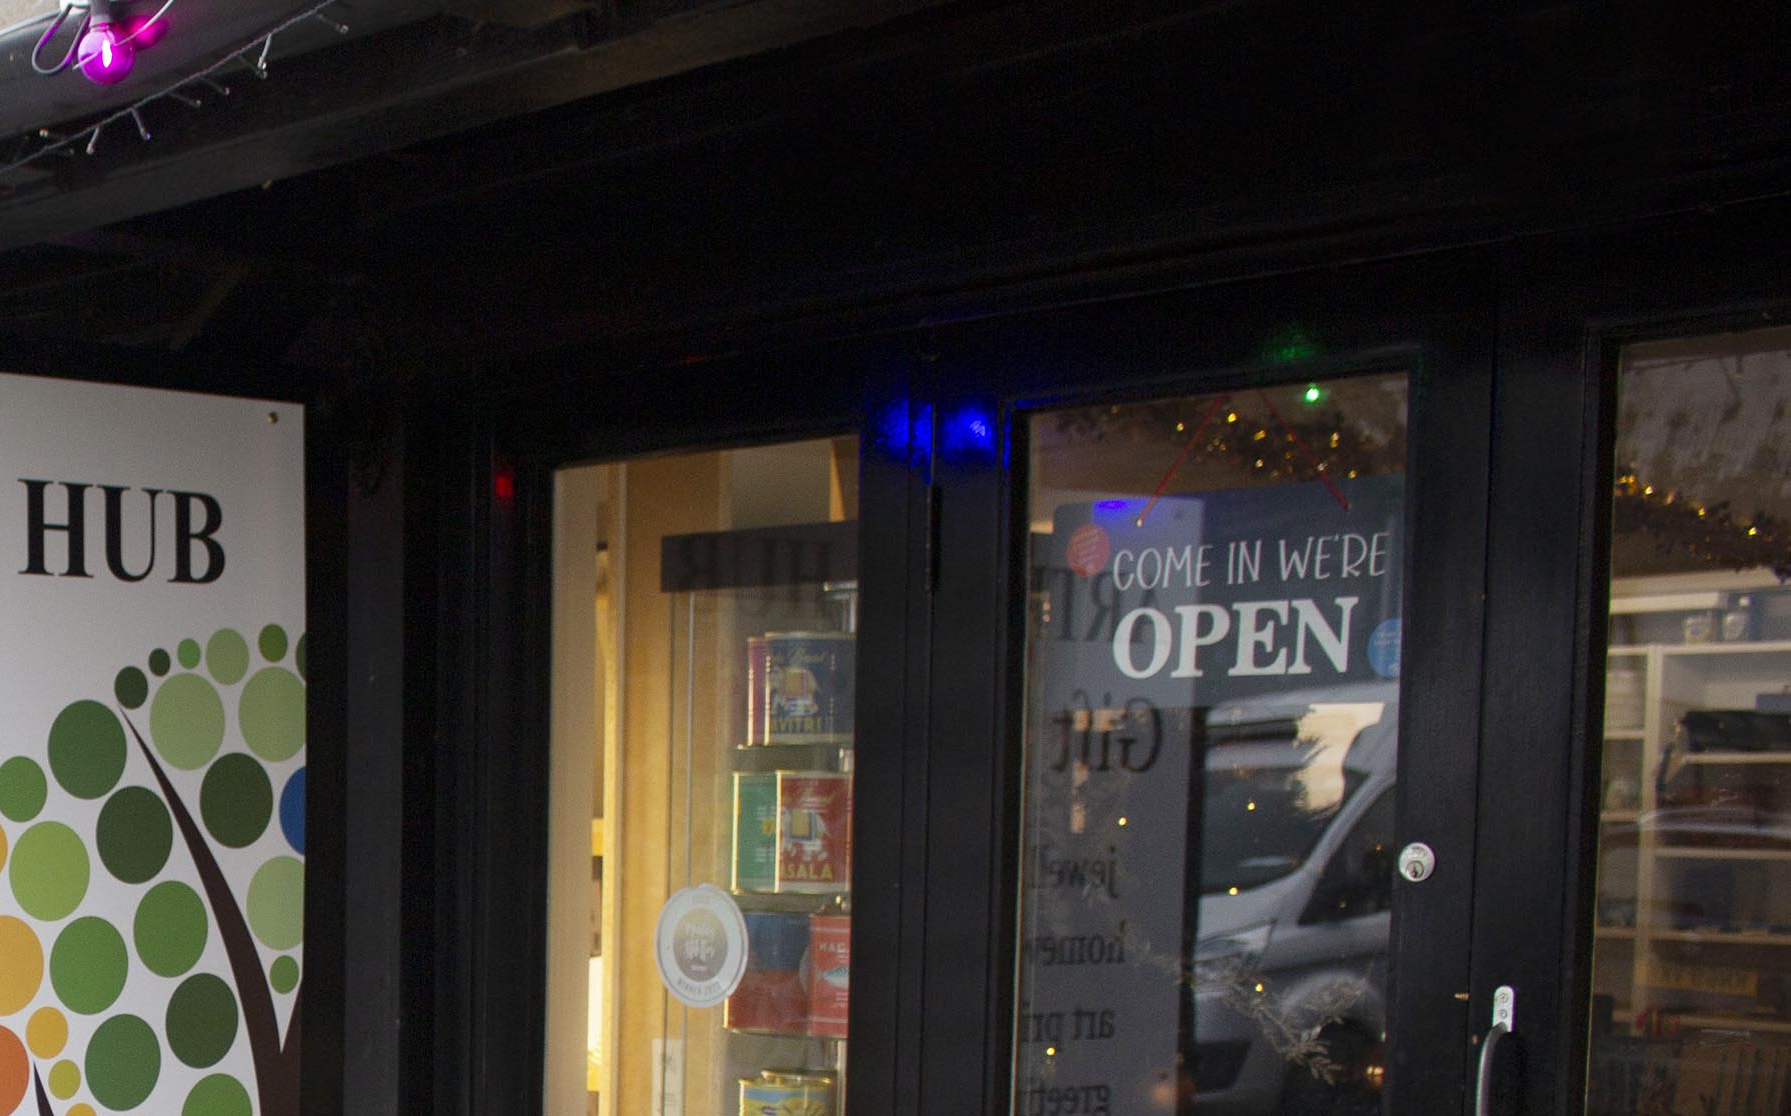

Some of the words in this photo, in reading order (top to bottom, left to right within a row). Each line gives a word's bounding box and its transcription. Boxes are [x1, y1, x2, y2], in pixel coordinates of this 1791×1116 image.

[17, 478, 227, 585] HUB
[1112, 545, 1210, 591] COME
[1228, 540, 1262, 584] IN
[1280, 532, 1391, 581] WE'RE
[1112, 597, 1359, 679] OPEN
